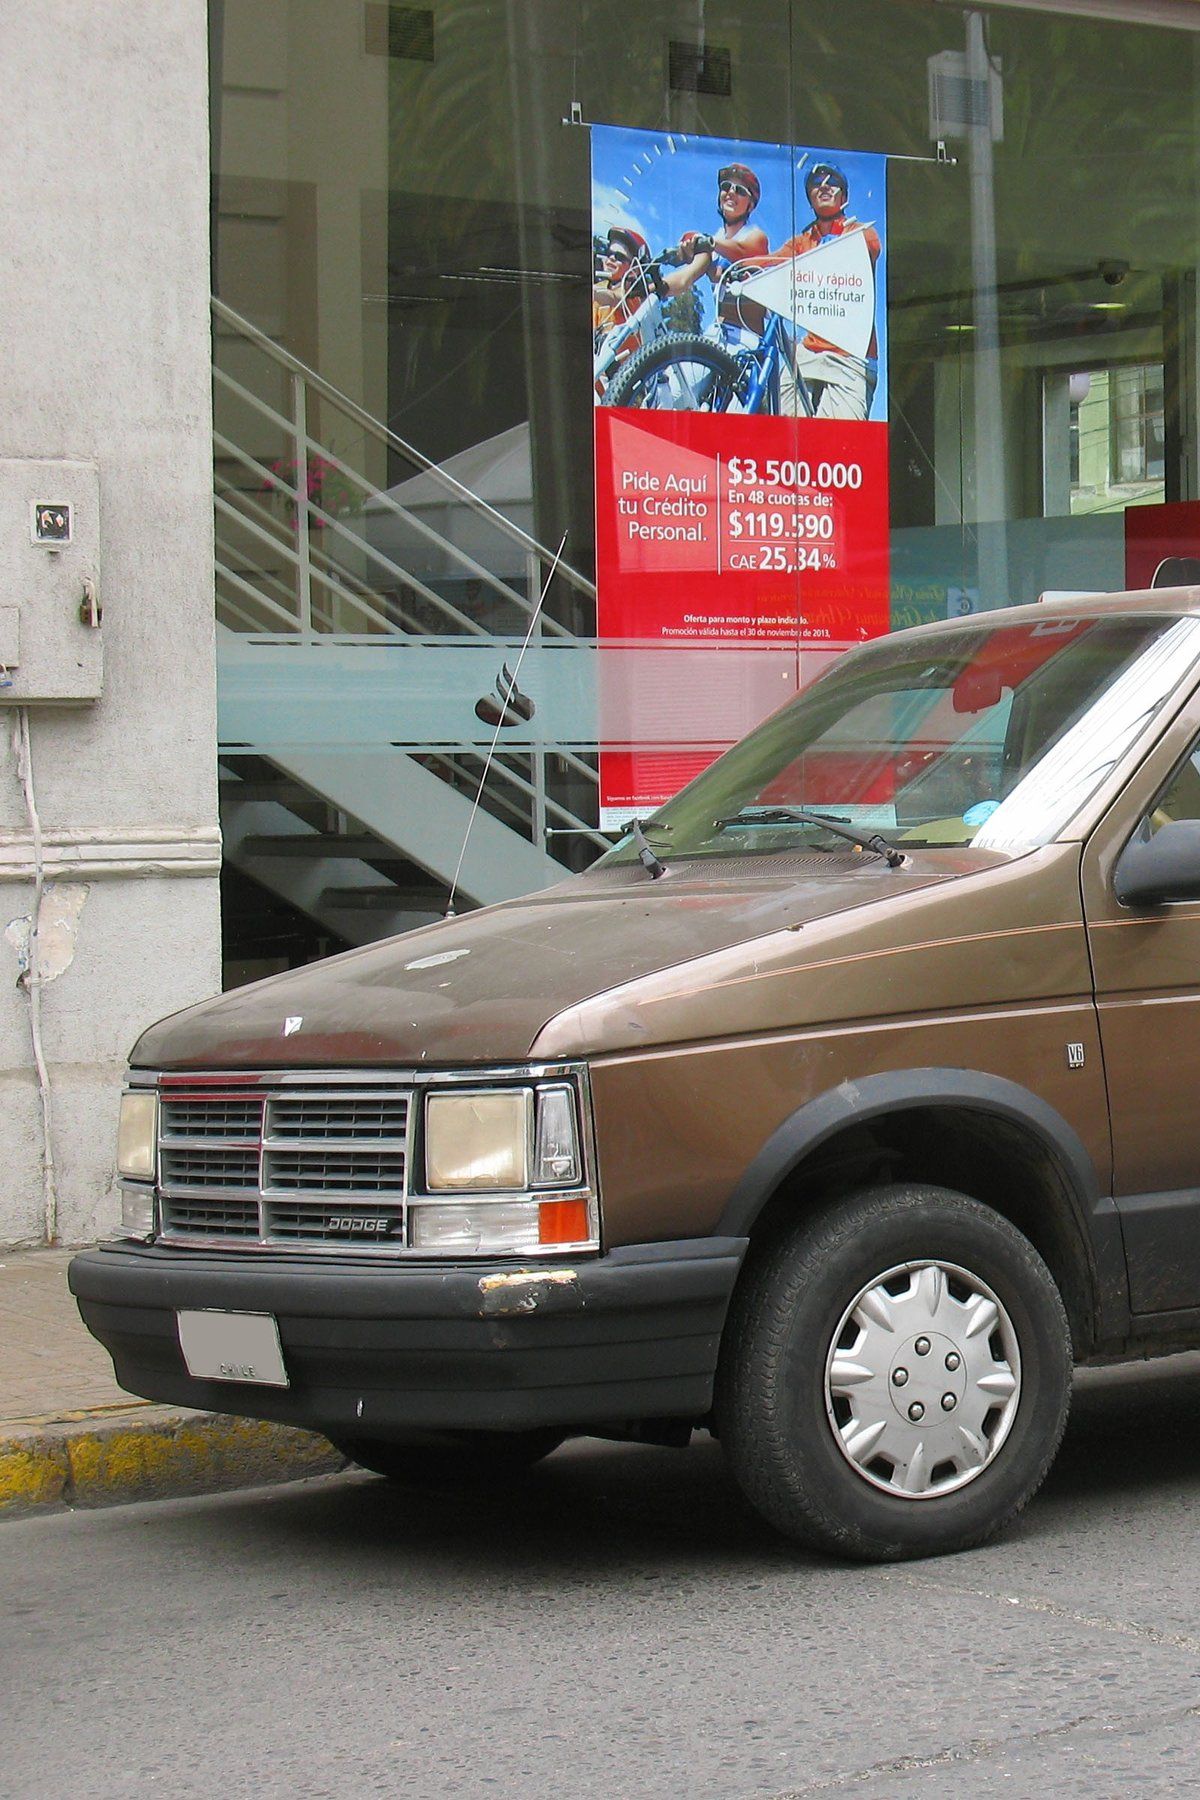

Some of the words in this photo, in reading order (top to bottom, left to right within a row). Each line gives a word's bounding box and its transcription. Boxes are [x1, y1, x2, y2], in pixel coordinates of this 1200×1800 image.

[817, 275, 824, 287] y
[827, 272, 863, 288] rápido
[790, 288, 816, 300] para
[818, 288, 866, 303] disfrutar
[808, 302, 846, 317] familia
[727, 456, 863, 489] $3.500.000
[622, 471, 660, 491] Pide
[664, 474, 707, 497] Aquí
[728, 489, 745, 503] En
[748, 490, 765, 504] 48
[767, 493, 810, 506] cuotas
[813, 492, 833, 507] de:
[618, 496, 638, 515] tu
[642, 496, 708, 517] Crédito
[629, 521, 708, 541] Personal.
[729, 509, 833, 538] $119.590
[729, 554, 757, 569] CAE
[683, 614, 708, 623] Oferta
[708, 616, 725, 625] para
[751, 617, 756, 625] y
[757, 615, 777, 625] plazo
[662, 626, 698, 635] Promoción
[720, 627, 738, 636] hasta
[740, 628, 747, 636] el
[757, 628, 766, 636] de
[803, 628, 812, 637] de
[1069, 1044, 1083, 1061] V6
[329, 1217, 388, 1231] DODGE
